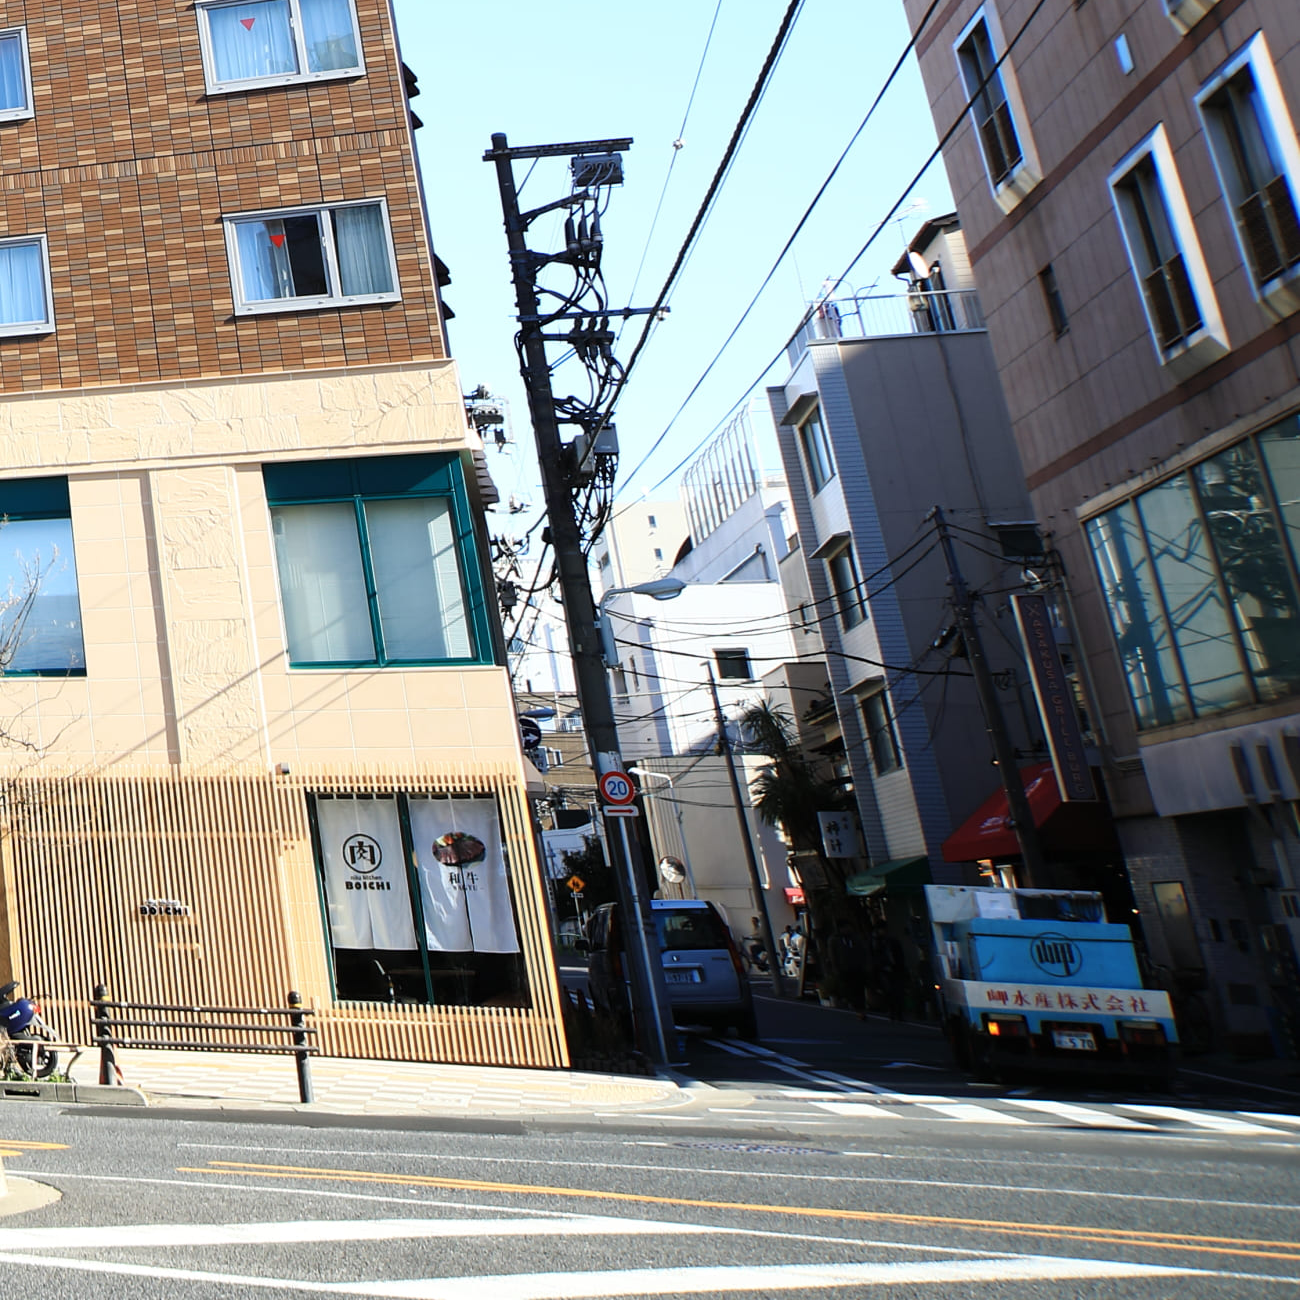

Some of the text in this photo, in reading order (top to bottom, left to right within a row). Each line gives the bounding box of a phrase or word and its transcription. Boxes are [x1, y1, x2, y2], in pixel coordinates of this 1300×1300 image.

[607, 780, 628, 796] 20
[449, 871, 479, 886] 和牛
[345, 881, 391, 891] BOICHI
[139, 906, 189, 916] BOICHI
